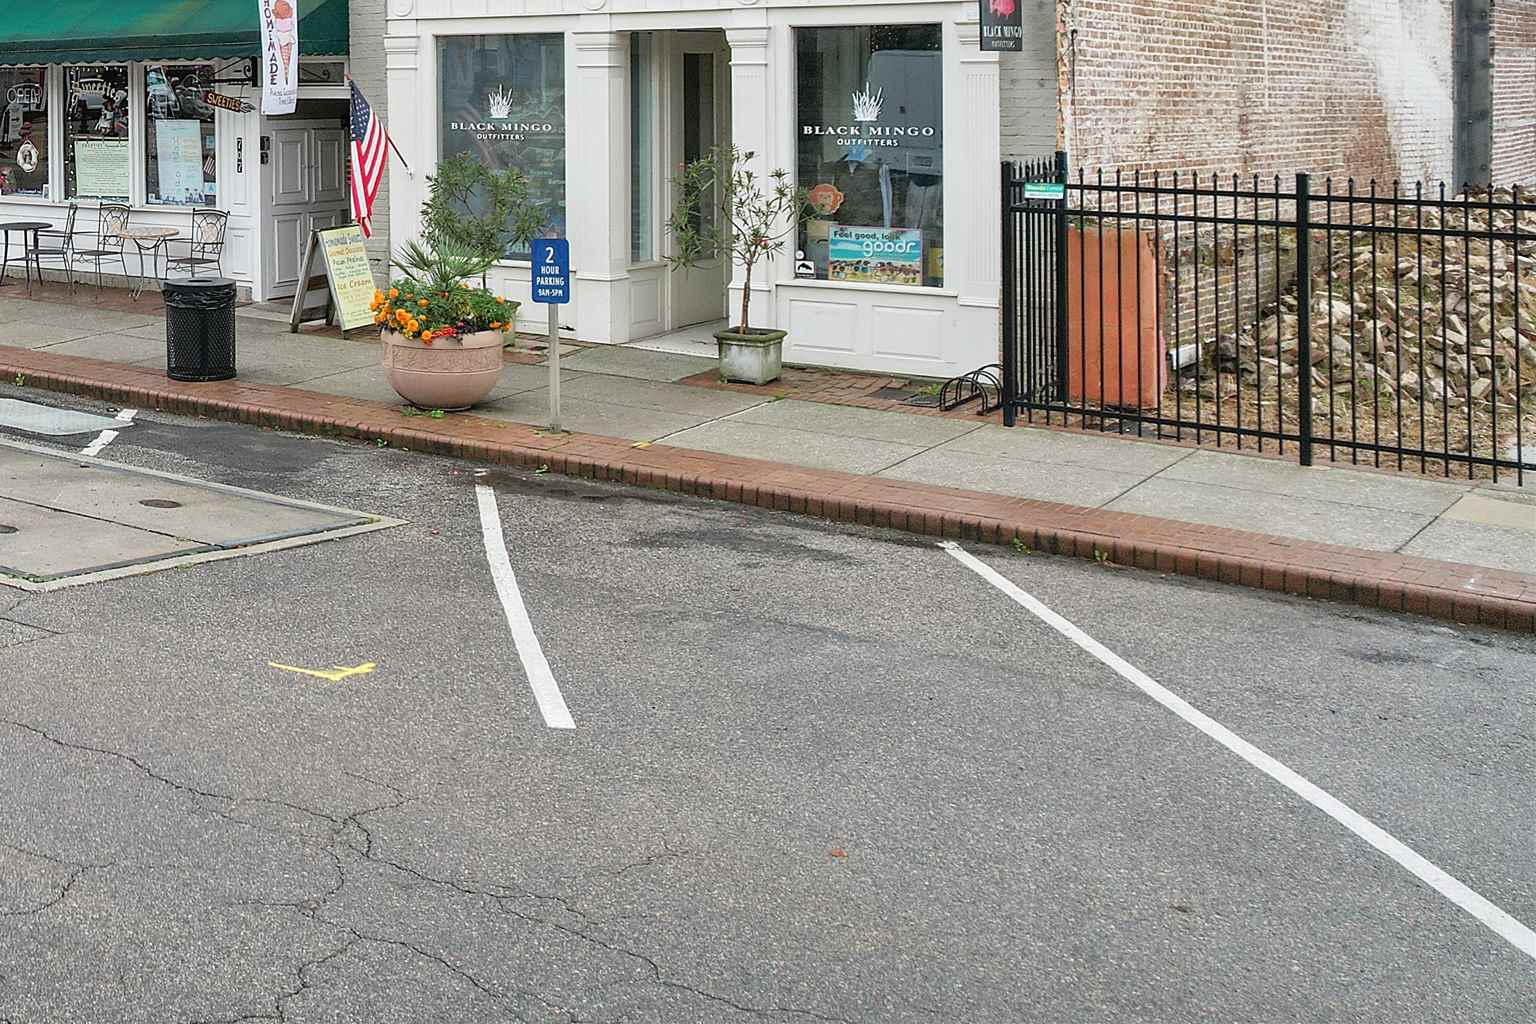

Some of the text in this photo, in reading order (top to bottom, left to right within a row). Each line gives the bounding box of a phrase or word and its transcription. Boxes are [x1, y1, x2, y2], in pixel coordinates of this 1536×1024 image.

[207, 93, 241, 111] SWEETIES
[451, 122, 552, 131] BLACK MINGO
[803, 126, 934, 136] BLACK MINGO
[837, 138, 898, 147] OUTFITTERS
[863, 240, 916, 257] goodr
[545, 247, 554, 263] 2
[541, 266, 560, 274] HOUR
[536, 277, 564, 286] PARKING
